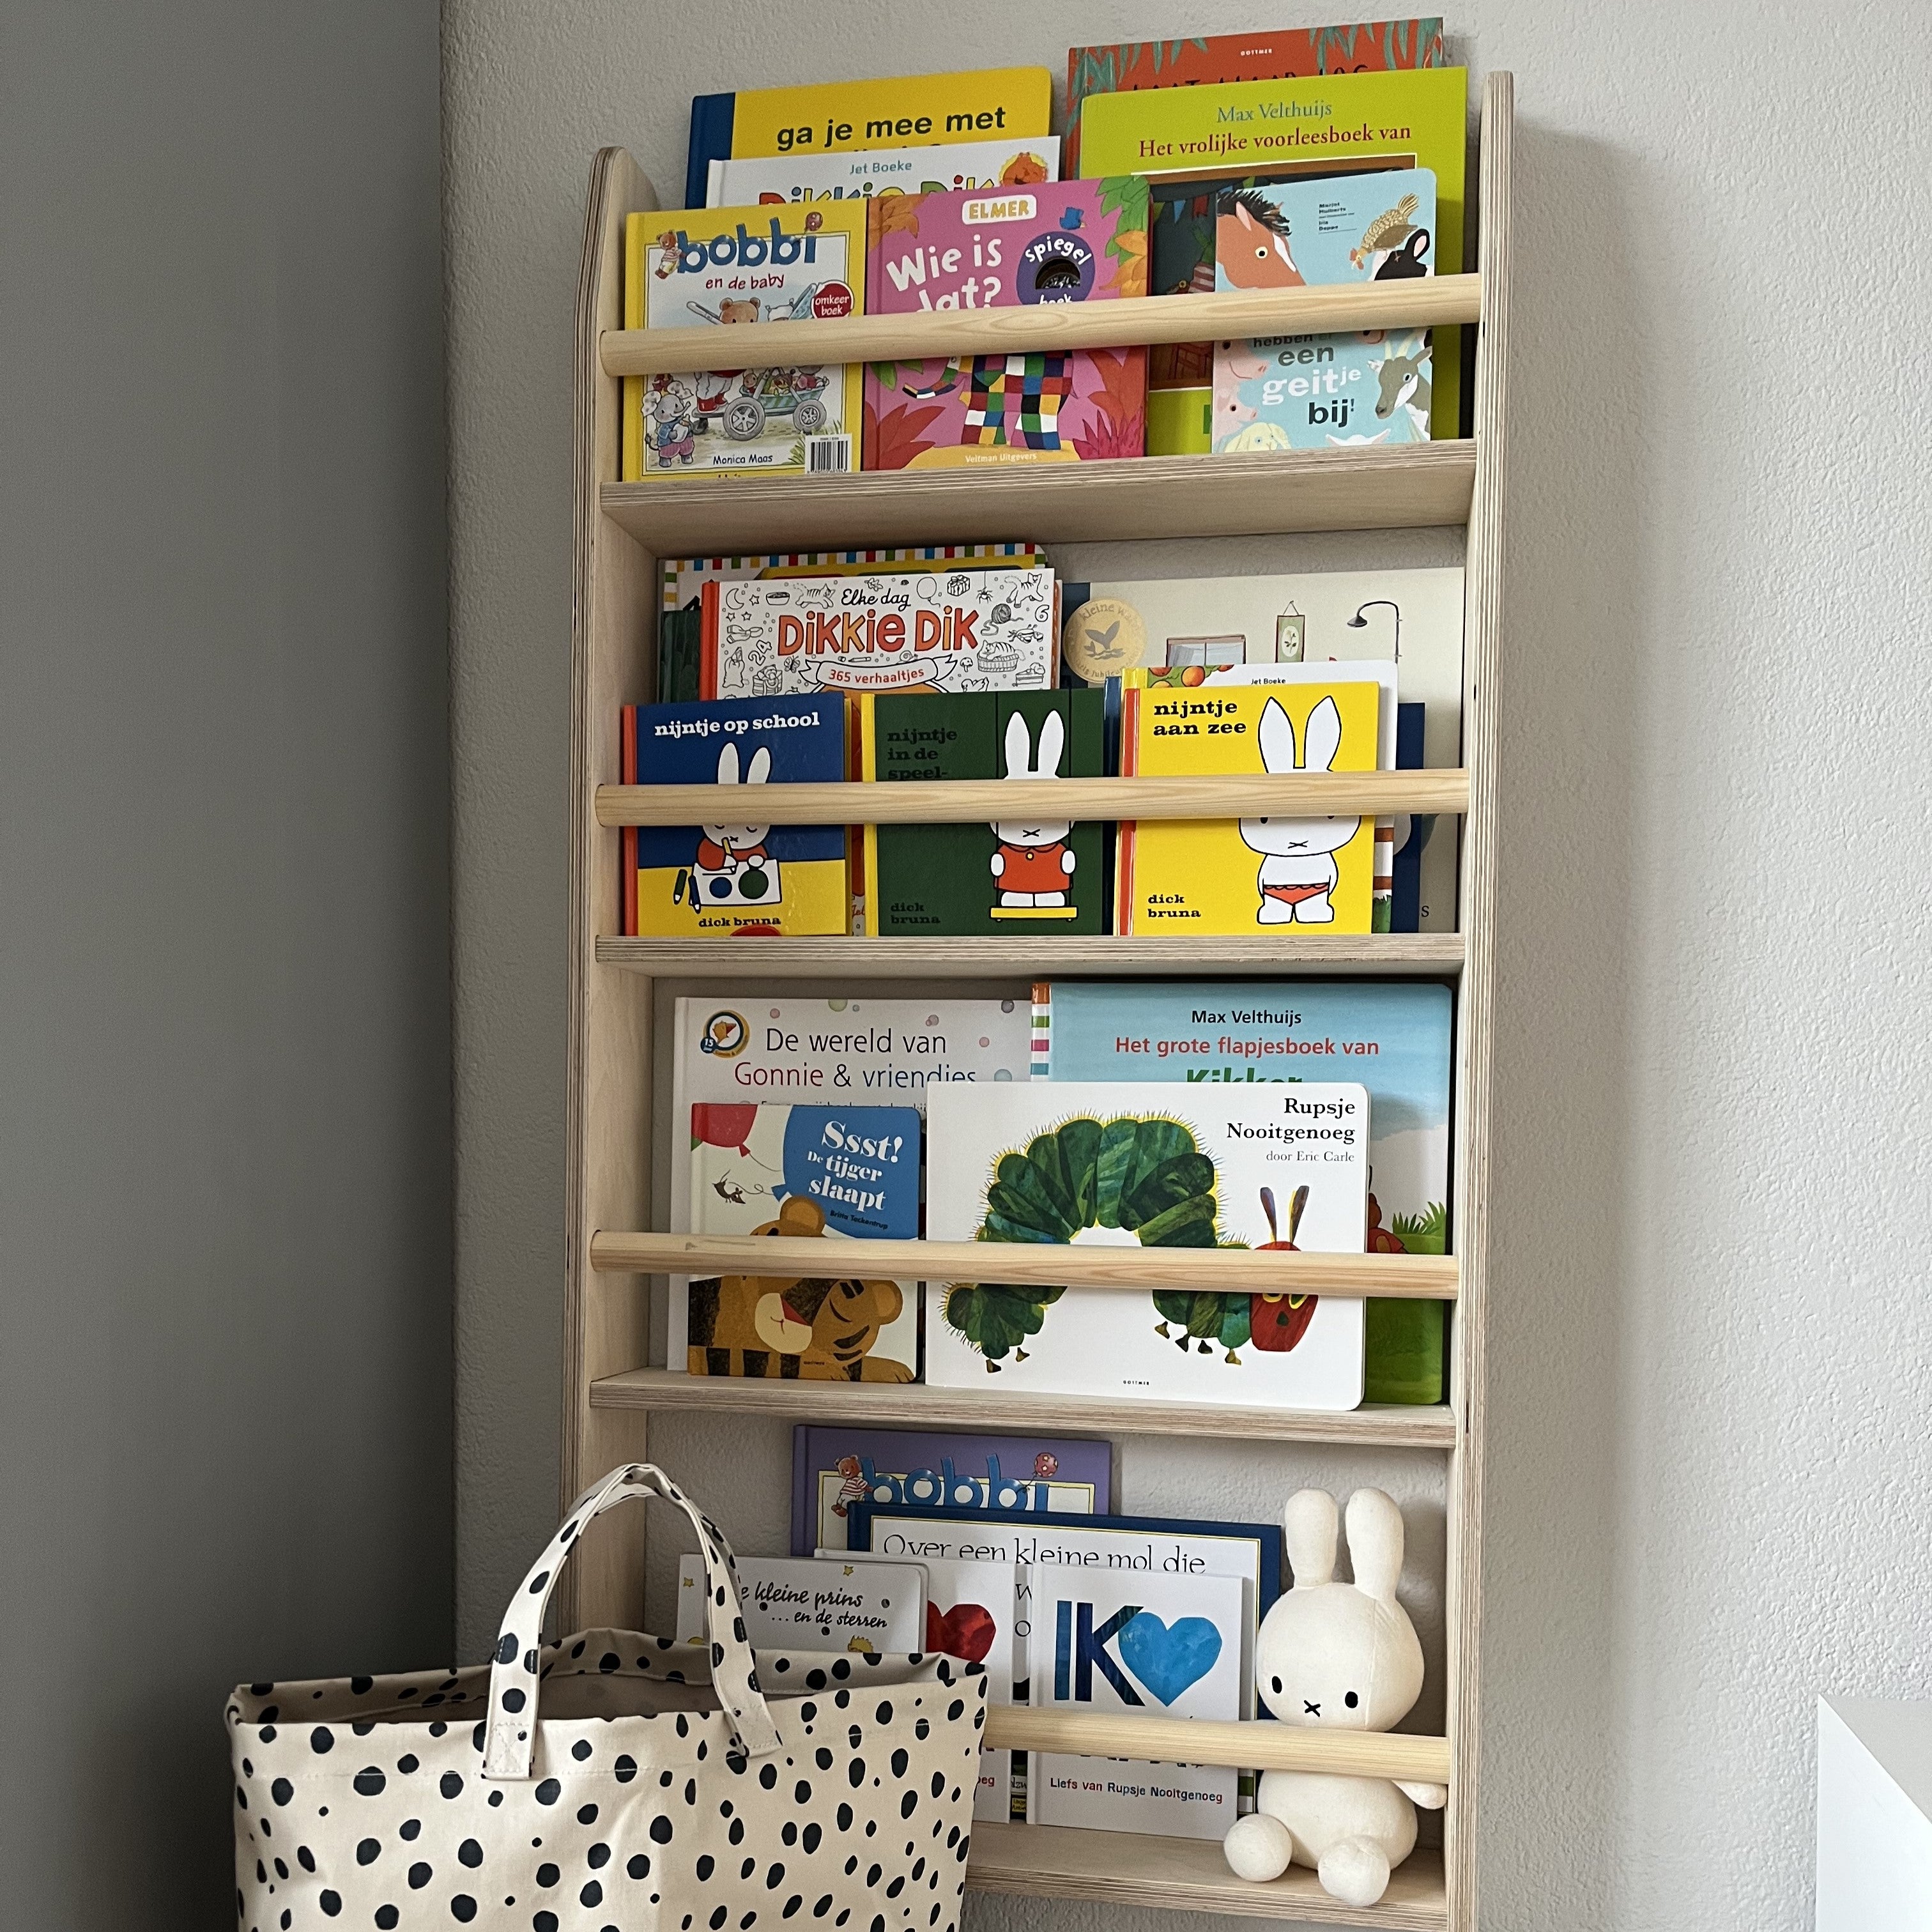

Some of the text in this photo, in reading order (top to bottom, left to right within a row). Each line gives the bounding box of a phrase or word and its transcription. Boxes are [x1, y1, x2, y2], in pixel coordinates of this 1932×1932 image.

[1217, 100, 1333, 123] Max Velthuijs
[776, 106, 1006, 151] ga je mee met
[1139, 123, 1411, 158] Het vrolijke voorleesboek van
[850, 160, 913, 176] Jet Boeke
[968, 199, 1029, 220] ELMER
[677, 217, 817, 273] bobbi
[1025, 235, 1092, 266] spiegel
[885, 234, 1002, 292] Wie is
[705, 273, 785, 290] en de baby
[815, 294, 850, 306] omkeer
[821, 303, 843, 317] boek
[1278, 346, 1334, 367] een
[1308, 398, 1355, 428] bij!
[712, 453, 773, 465] Monica Maas
[965, 452, 1037, 464] Veltman Uitgevers
[841, 588, 912, 611] Elke dag
[828, 667, 925, 685] 365 verhaaltjes
[1153, 699, 1238, 719] nijntje
[655, 712, 820, 739] nijntje op school
[887, 728, 958, 744] nijntje
[1153, 721, 1247, 737] aan zee
[887, 746, 939, 761] in de
[891, 901, 925, 912] dick
[1147, 894, 1185, 905] dick
[698, 917, 782, 928] dick bruna
[891, 914, 941, 924] bruna
[1147, 908, 1202, 919] bruna
[1191, 1009, 1302, 1027] Max Velthuijs
[767, 1027, 799, 1052] De
[809, 1027, 893, 1054] wereld
[902, 1035, 947, 1054] van
[1116, 1036, 1379, 1059] Het grote flapjesboek van
[735, 1061, 824, 1087] Gonnie
[832, 1063, 852, 1087] &
[1284, 1098, 1355, 1119] Rupsje
[821, 1119, 903, 1164] Ssst!
[1226, 1122, 1355, 1144] Nooitgenoeg
[807, 1150, 883, 1183] De tijger
[1266, 1150, 1354, 1163] door Eric Carle
[808, 1175, 887, 1212] slaapt
[862, 1453, 1050, 1514] bobbi
[883, 1534, 1206, 1574] Over een kleine mol die
[755, 1581, 810, 1604] kleine
[815, 1587, 864, 1611] prins
[794, 1611, 812, 1623] en
[815, 1608, 833, 1625] de
[836, 1611, 887, 1629] sterren
[1054, 1600, 1146, 1706] IK
[1050, 1777, 1223, 1805] Liefs van Rupsje Nooitgenoeg
